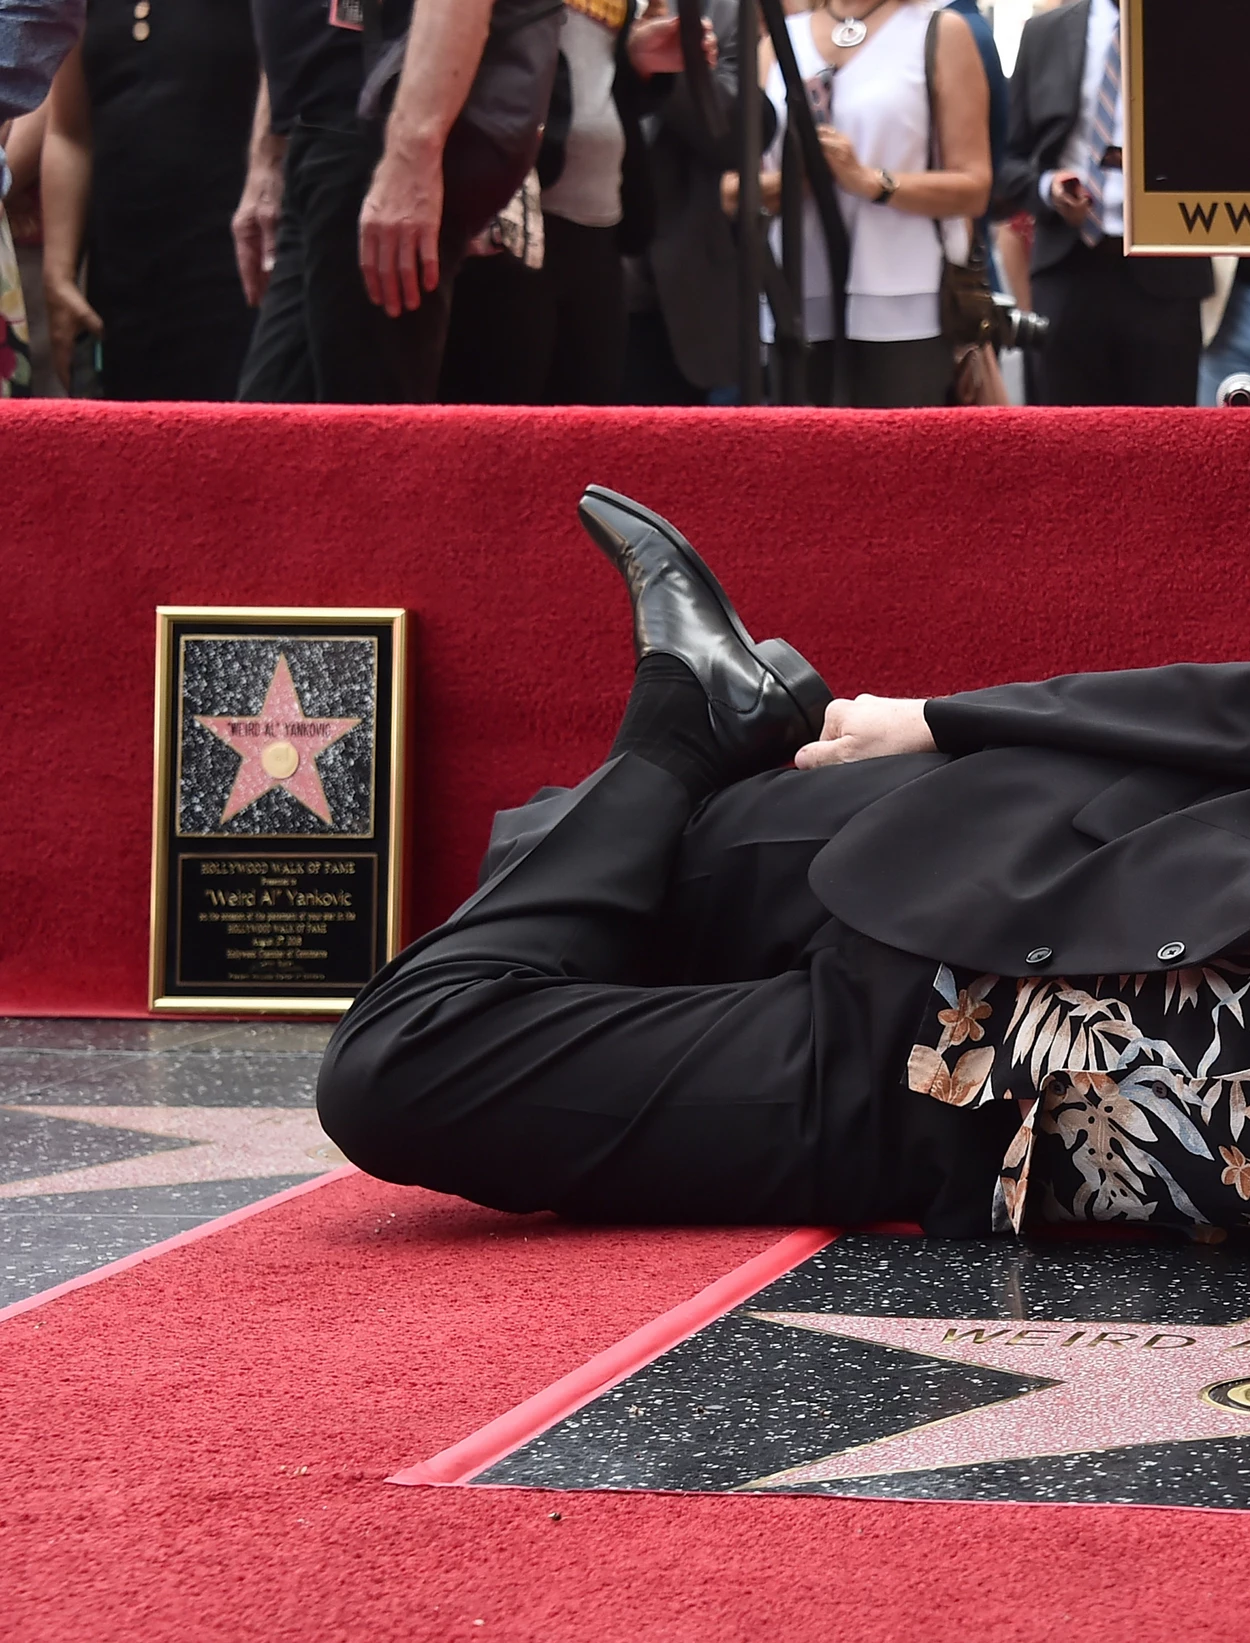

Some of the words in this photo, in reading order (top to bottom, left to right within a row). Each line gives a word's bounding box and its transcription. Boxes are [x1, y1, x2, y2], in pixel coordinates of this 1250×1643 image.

[285, 723, 331, 738] YANKOVIC
[201, 861, 269, 875] HOLLYWOOD
[271, 861, 305, 875] WALK
[307, 861, 321, 875] OF
[323, 861, 357, 875] FAME
[285, 888, 353, 908] Yankovic
